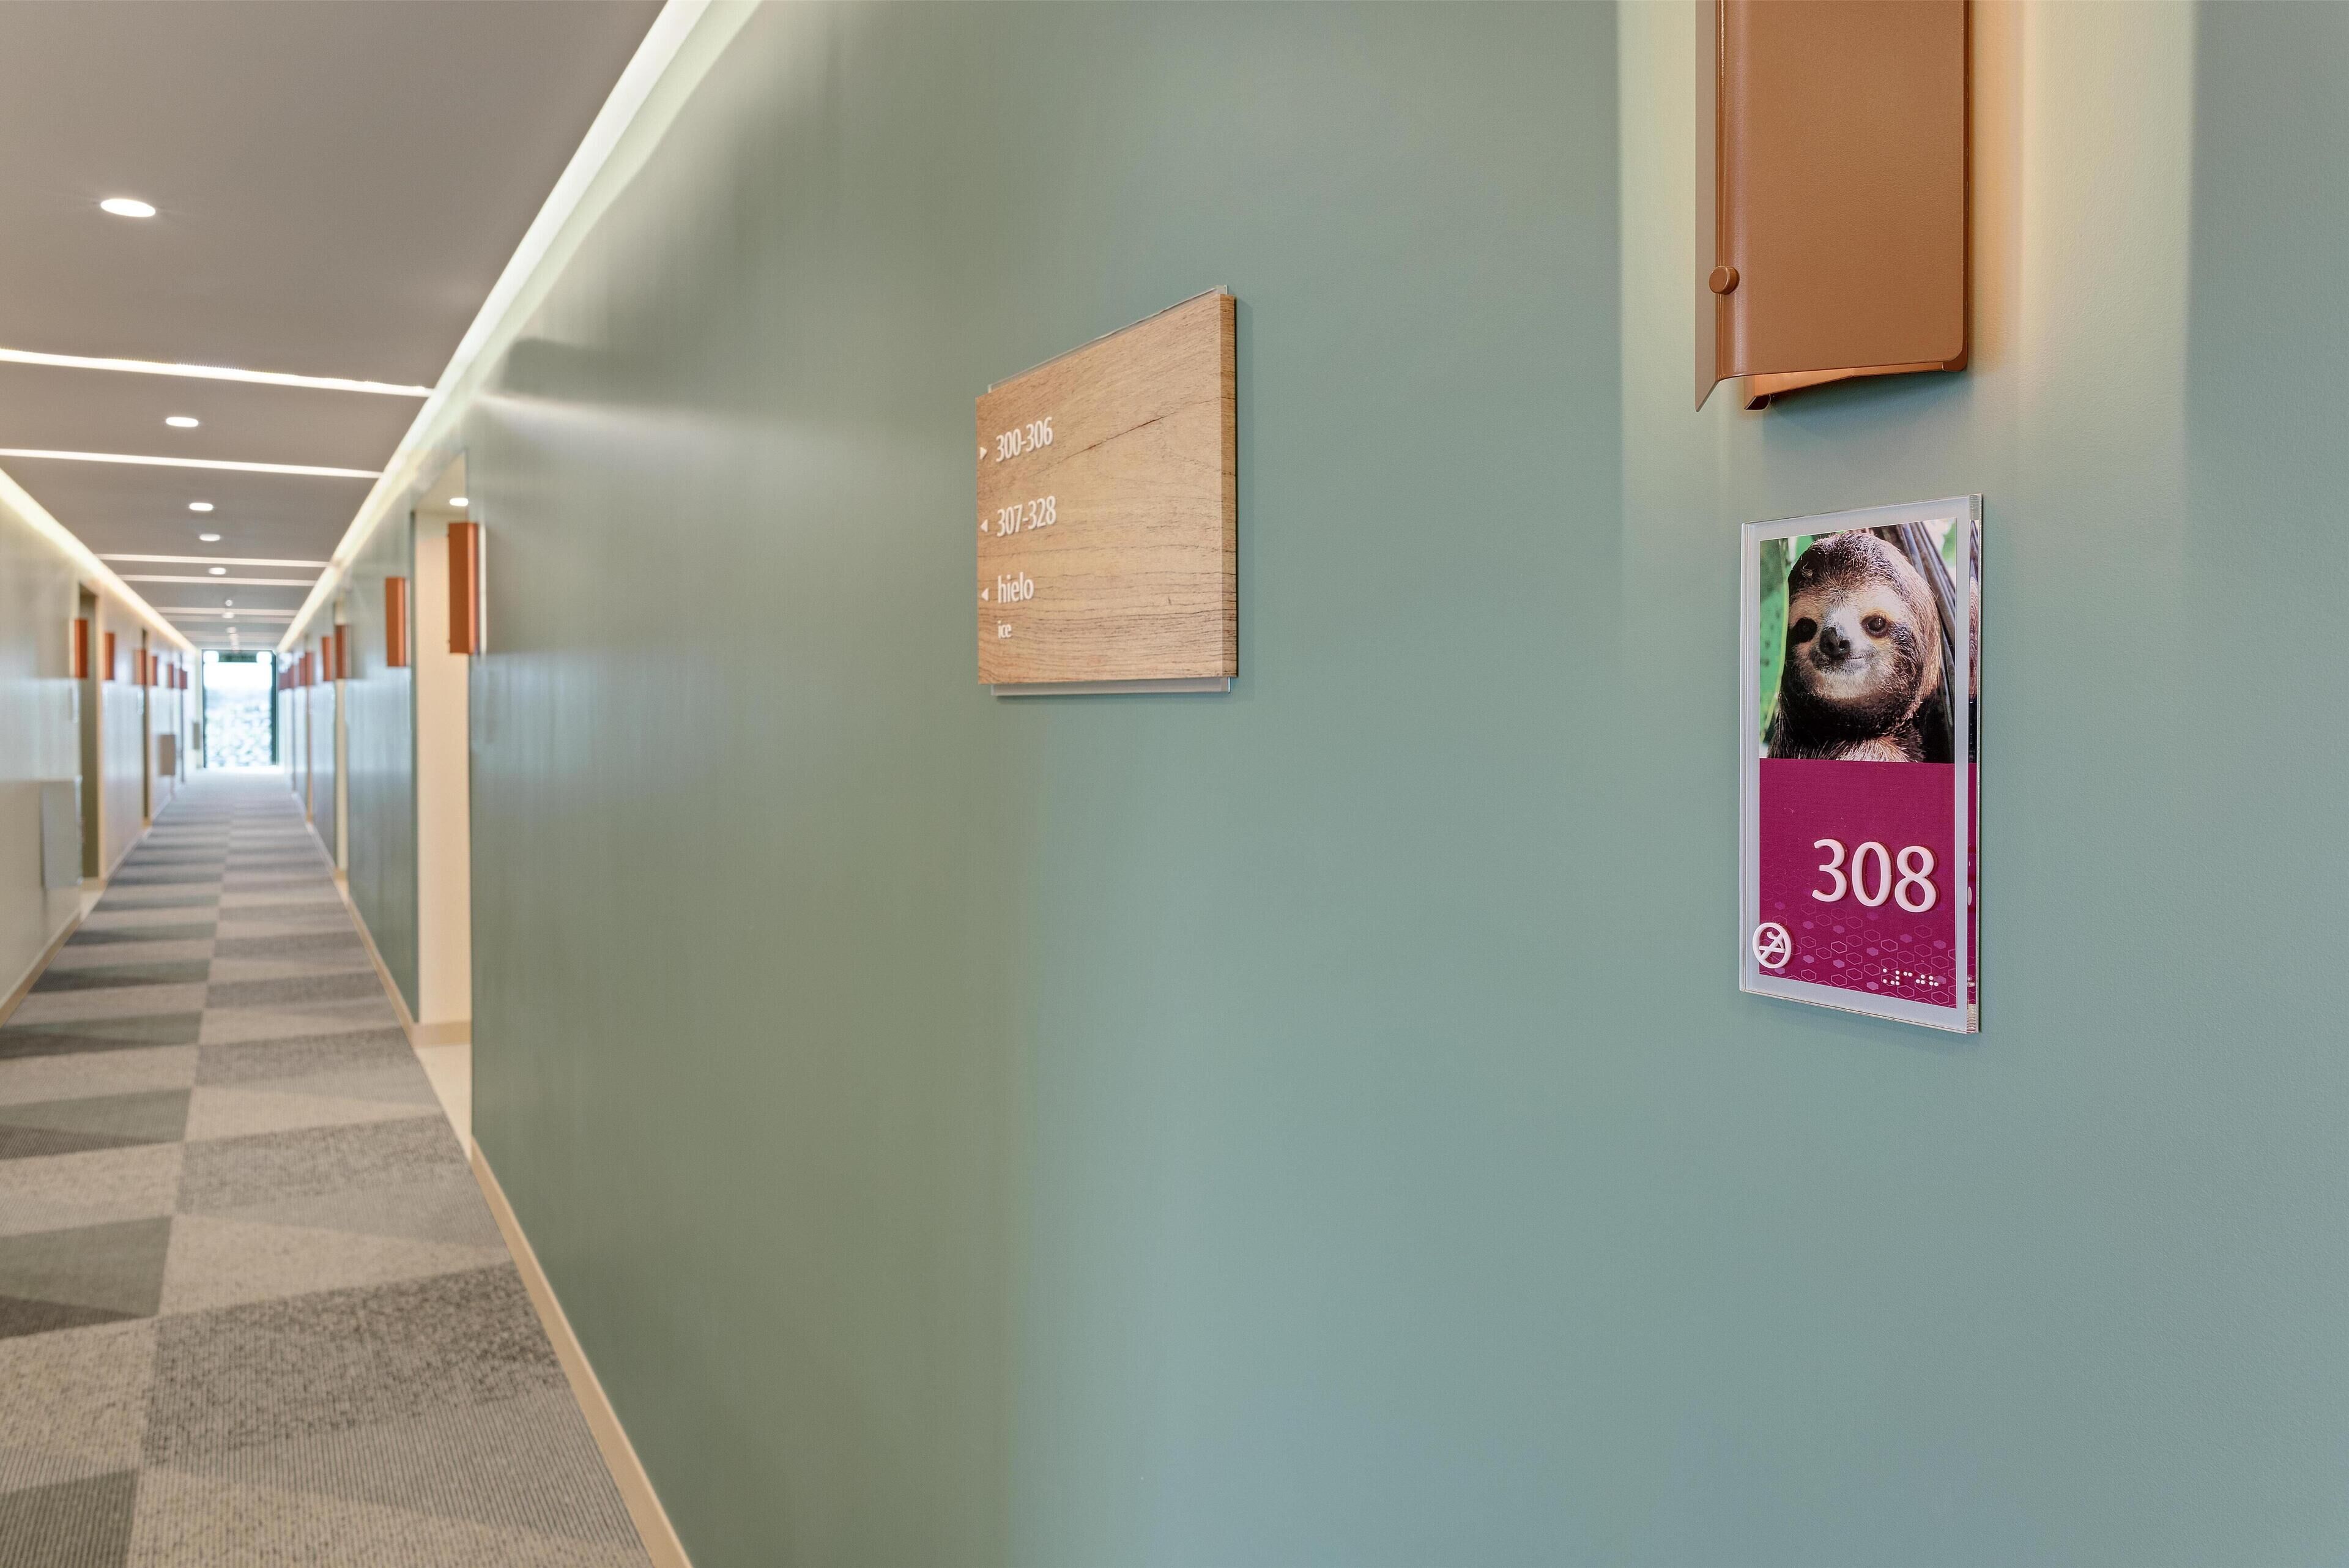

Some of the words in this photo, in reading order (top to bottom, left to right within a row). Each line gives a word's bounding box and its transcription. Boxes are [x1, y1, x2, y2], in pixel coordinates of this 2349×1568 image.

[996, 417, 1053, 463] 300-306
[997, 496, 1057, 537] 307-328
[998, 571, 1034, 604] hielo
[998, 620, 1012, 639] ice
[1811, 839, 1937, 913] 308
